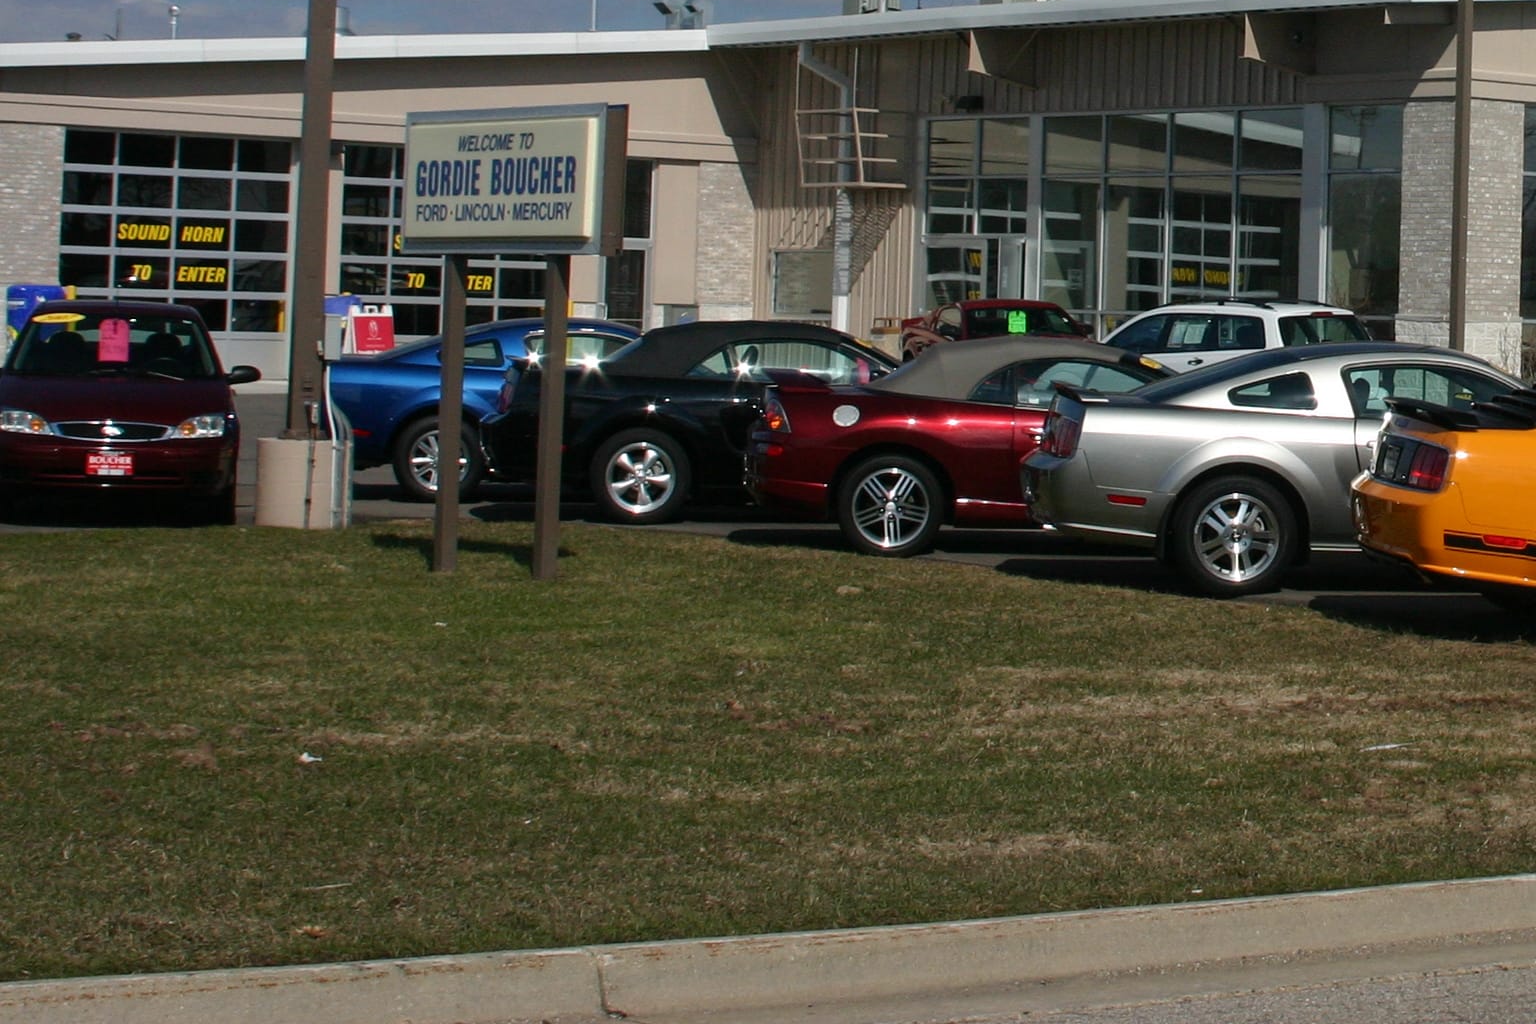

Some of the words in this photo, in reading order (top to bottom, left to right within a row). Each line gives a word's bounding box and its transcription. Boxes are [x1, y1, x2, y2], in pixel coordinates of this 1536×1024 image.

[458, 133, 514, 152] WELCOME
[519, 132, 533, 150] TO
[416, 159, 481, 197] GORDIE
[490, 156, 576, 196] BOUCHER
[416, 203, 448, 222] FORD
[455, 203, 505, 221] LINCOLN
[512, 202, 572, 221] MERCURY
[118, 223, 171, 242] SOUND
[181, 225, 224, 243] HORN
[131, 264, 153, 281] TO
[177, 265, 227, 283] ENTER
[407, 273, 425, 288] TO
